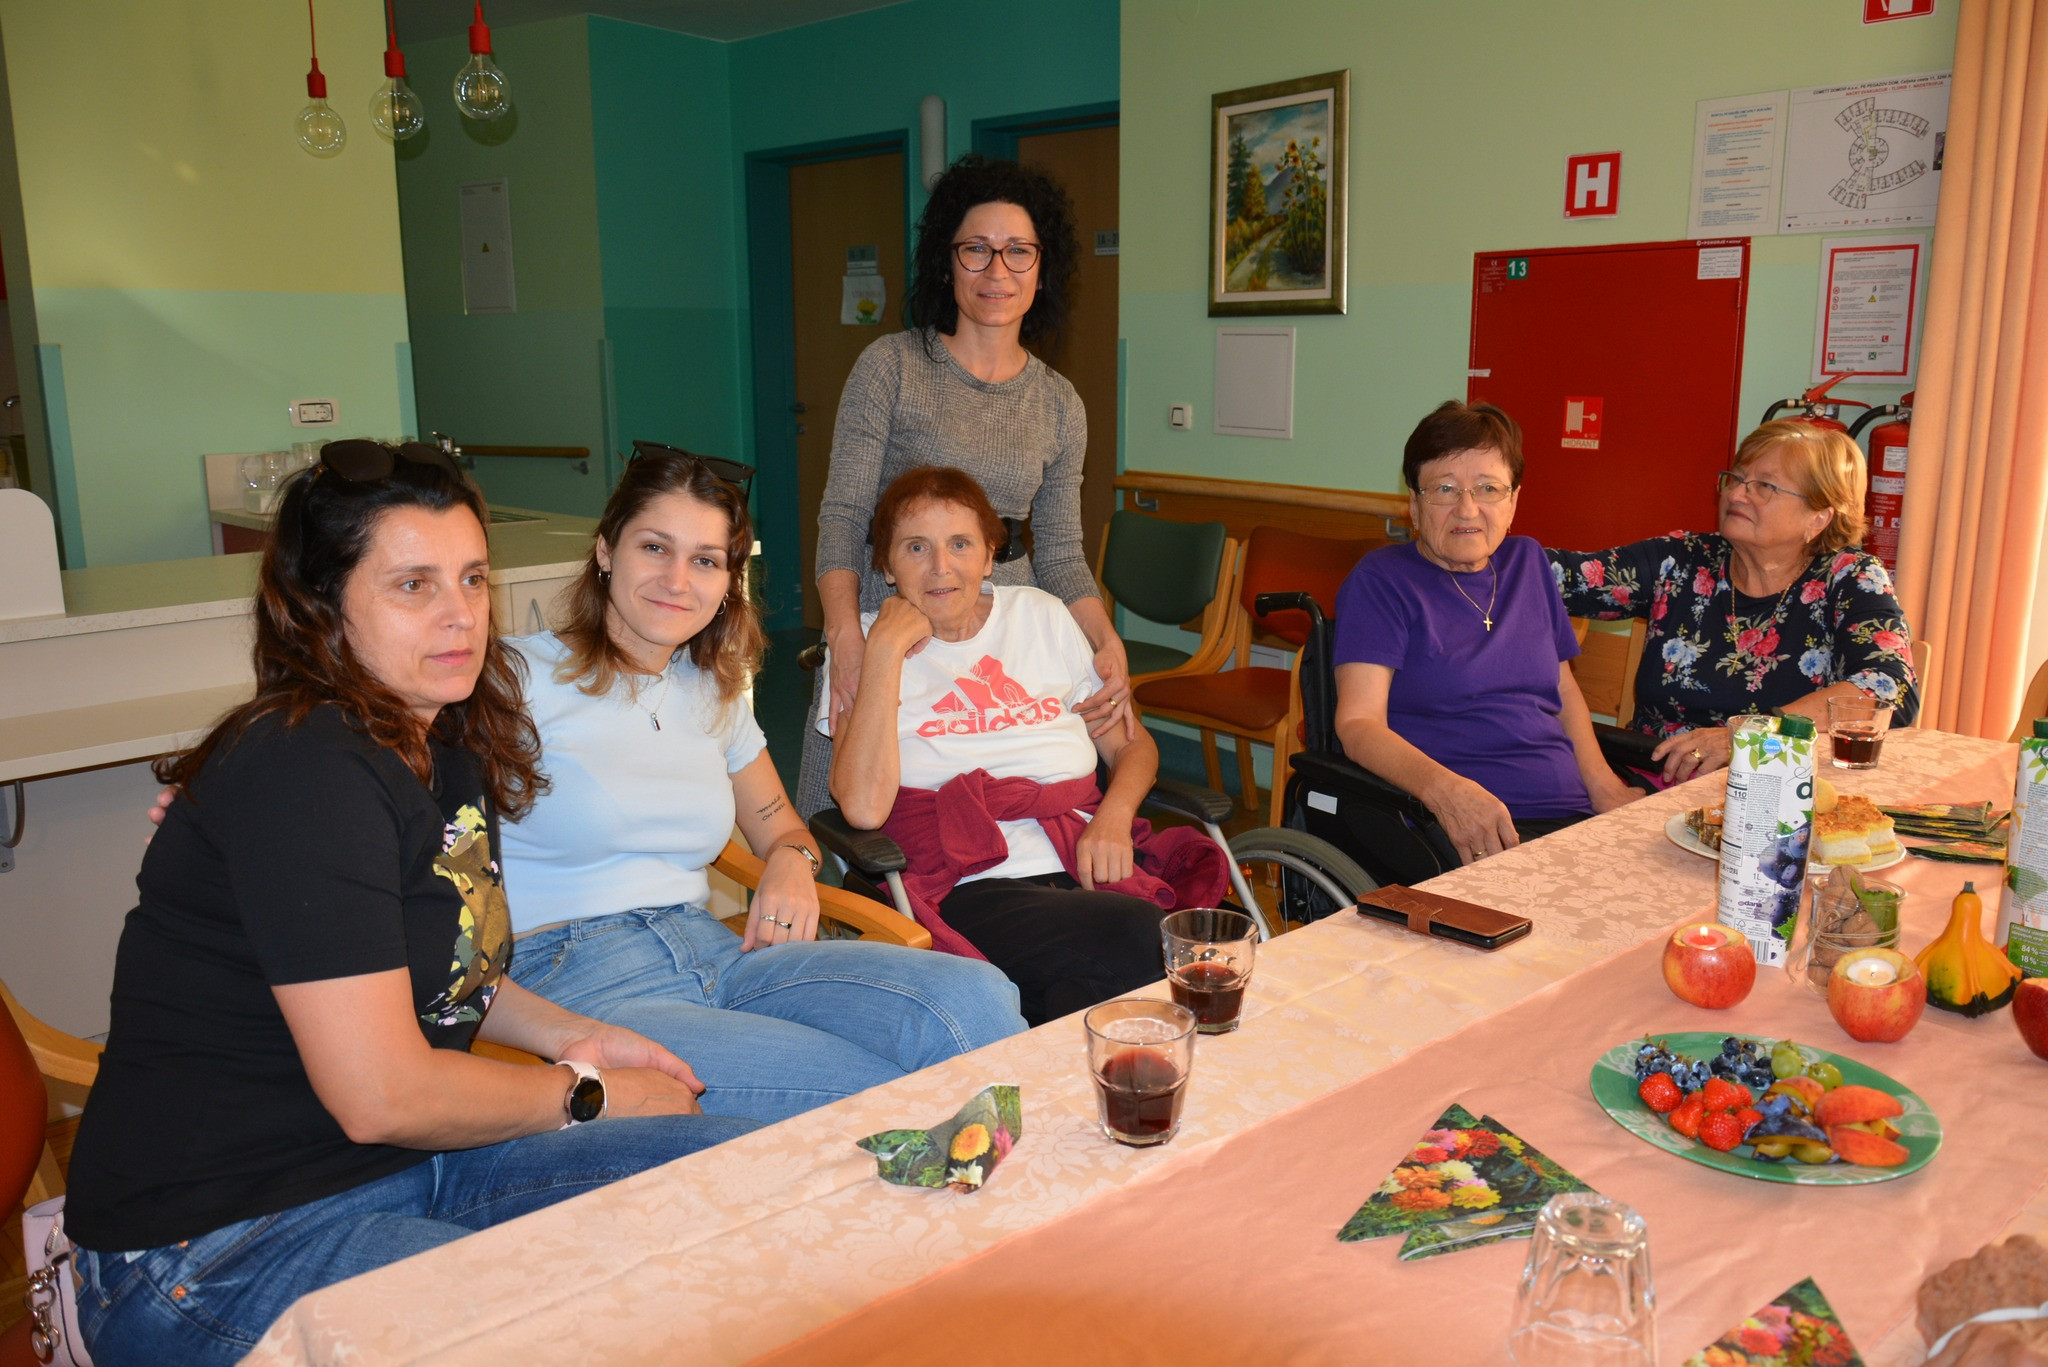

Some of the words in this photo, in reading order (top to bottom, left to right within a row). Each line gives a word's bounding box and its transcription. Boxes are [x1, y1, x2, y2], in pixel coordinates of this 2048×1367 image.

[1574, 162, 1611, 209] H
[1509, 260, 1527, 277] 13
[1563, 438, 1598, 449] HIDRANT
[916, 697, 1062, 738] adidas
[1764, 743, 1780, 751] dana
[1734, 790, 1747, 799] 110
[1744, 900, 1763, 908] dana
